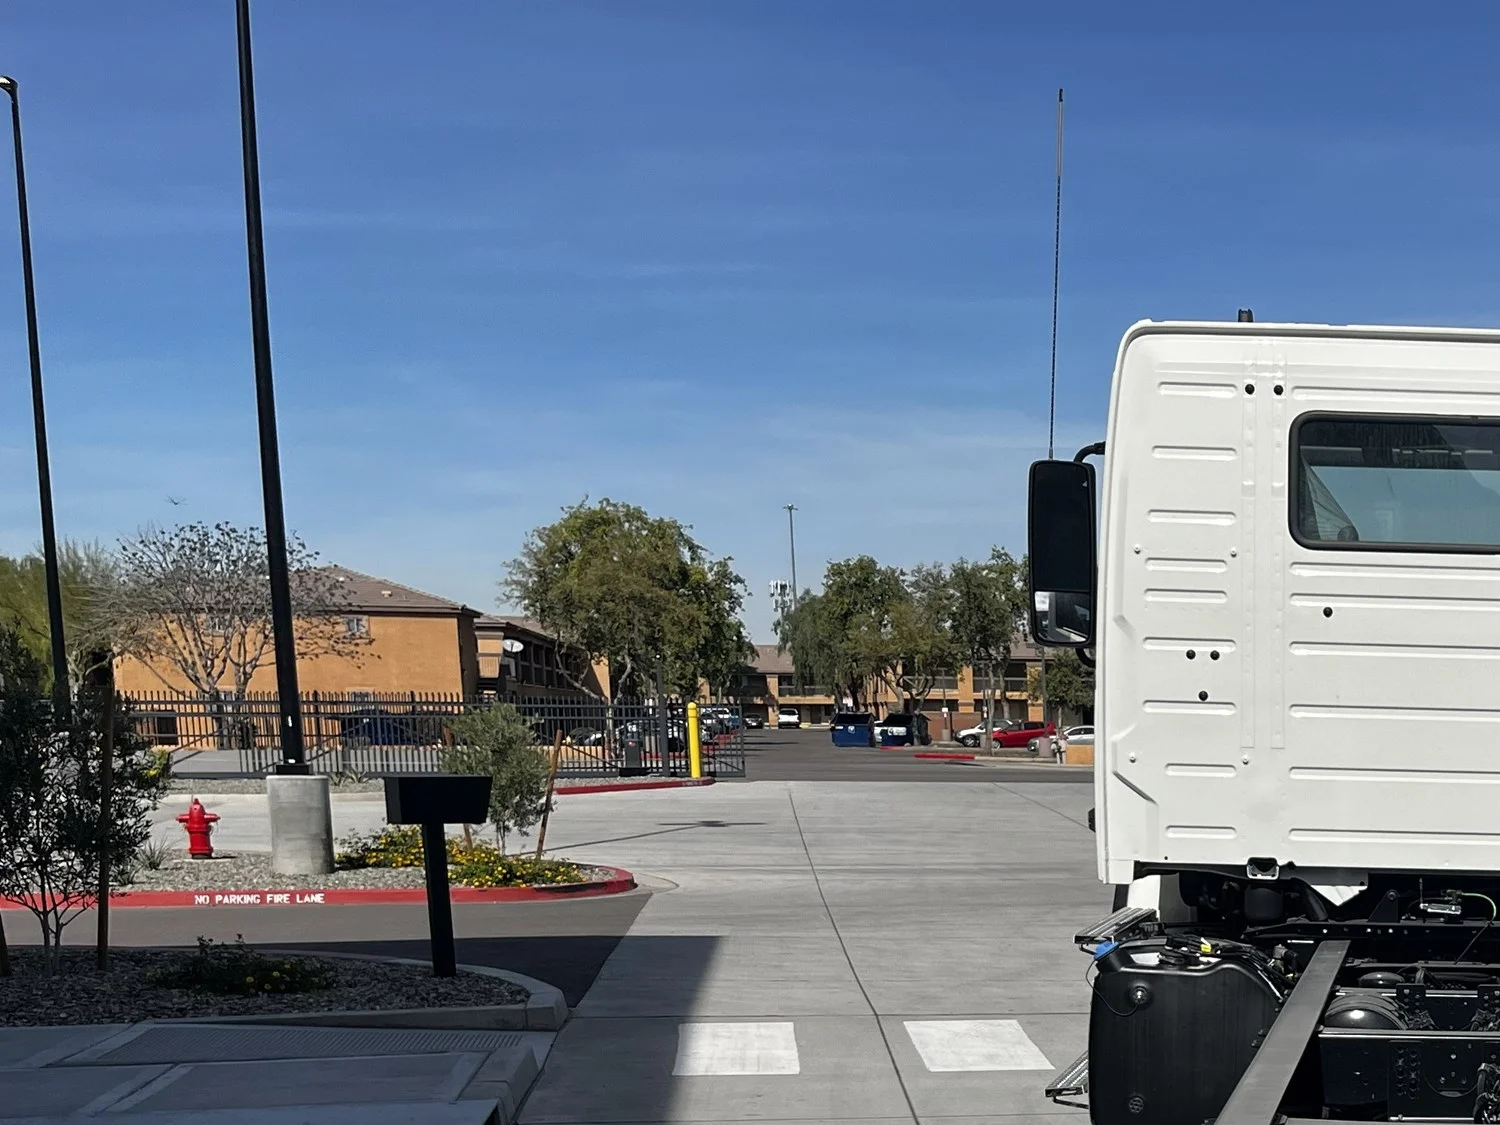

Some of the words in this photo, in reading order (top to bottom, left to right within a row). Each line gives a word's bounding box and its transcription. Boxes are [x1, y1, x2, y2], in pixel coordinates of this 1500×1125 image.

[194, 894, 210, 905] NO
[215, 894, 261, 905] PARKING
[266, 893, 291, 904] FIRE
[296, 893, 325, 904] LANE
